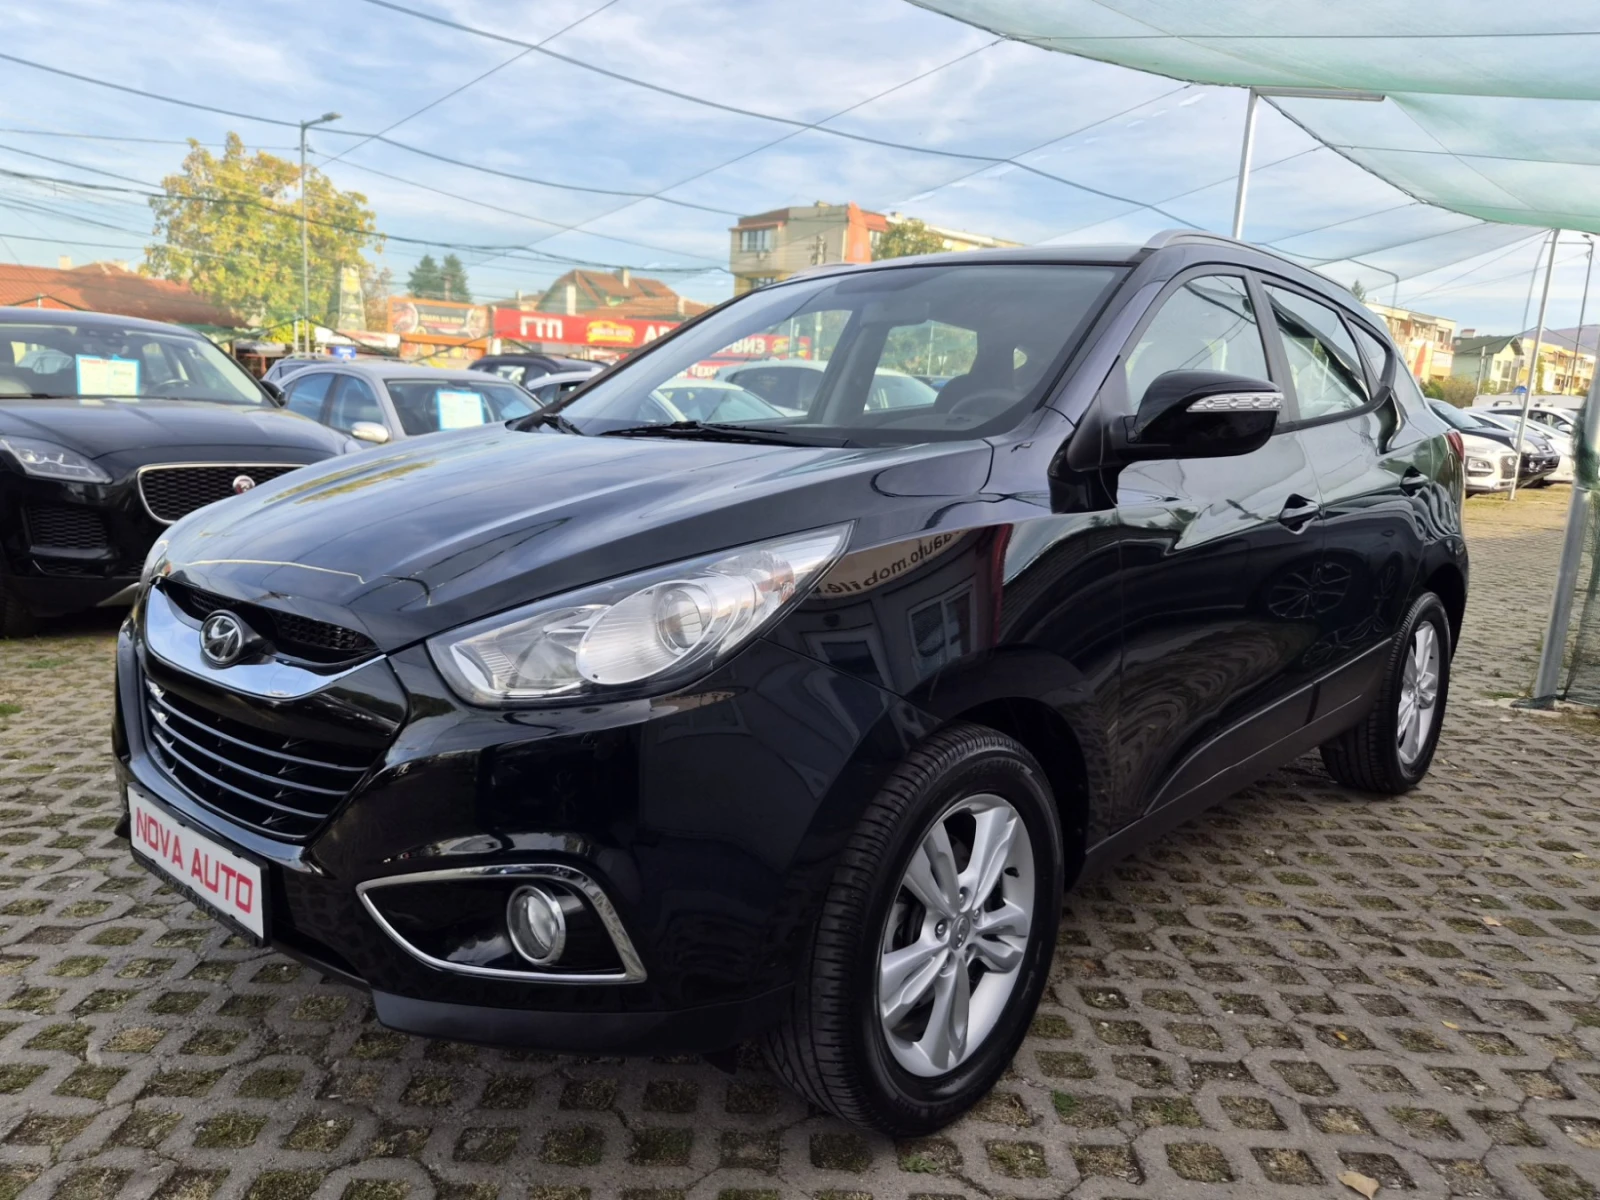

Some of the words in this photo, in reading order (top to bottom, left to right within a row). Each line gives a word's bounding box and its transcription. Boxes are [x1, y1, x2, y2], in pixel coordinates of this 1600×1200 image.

[520, 315, 563, 339] ГТП
[136, 807, 184, 870] NOVA
[191, 847, 253, 914] AUTO
